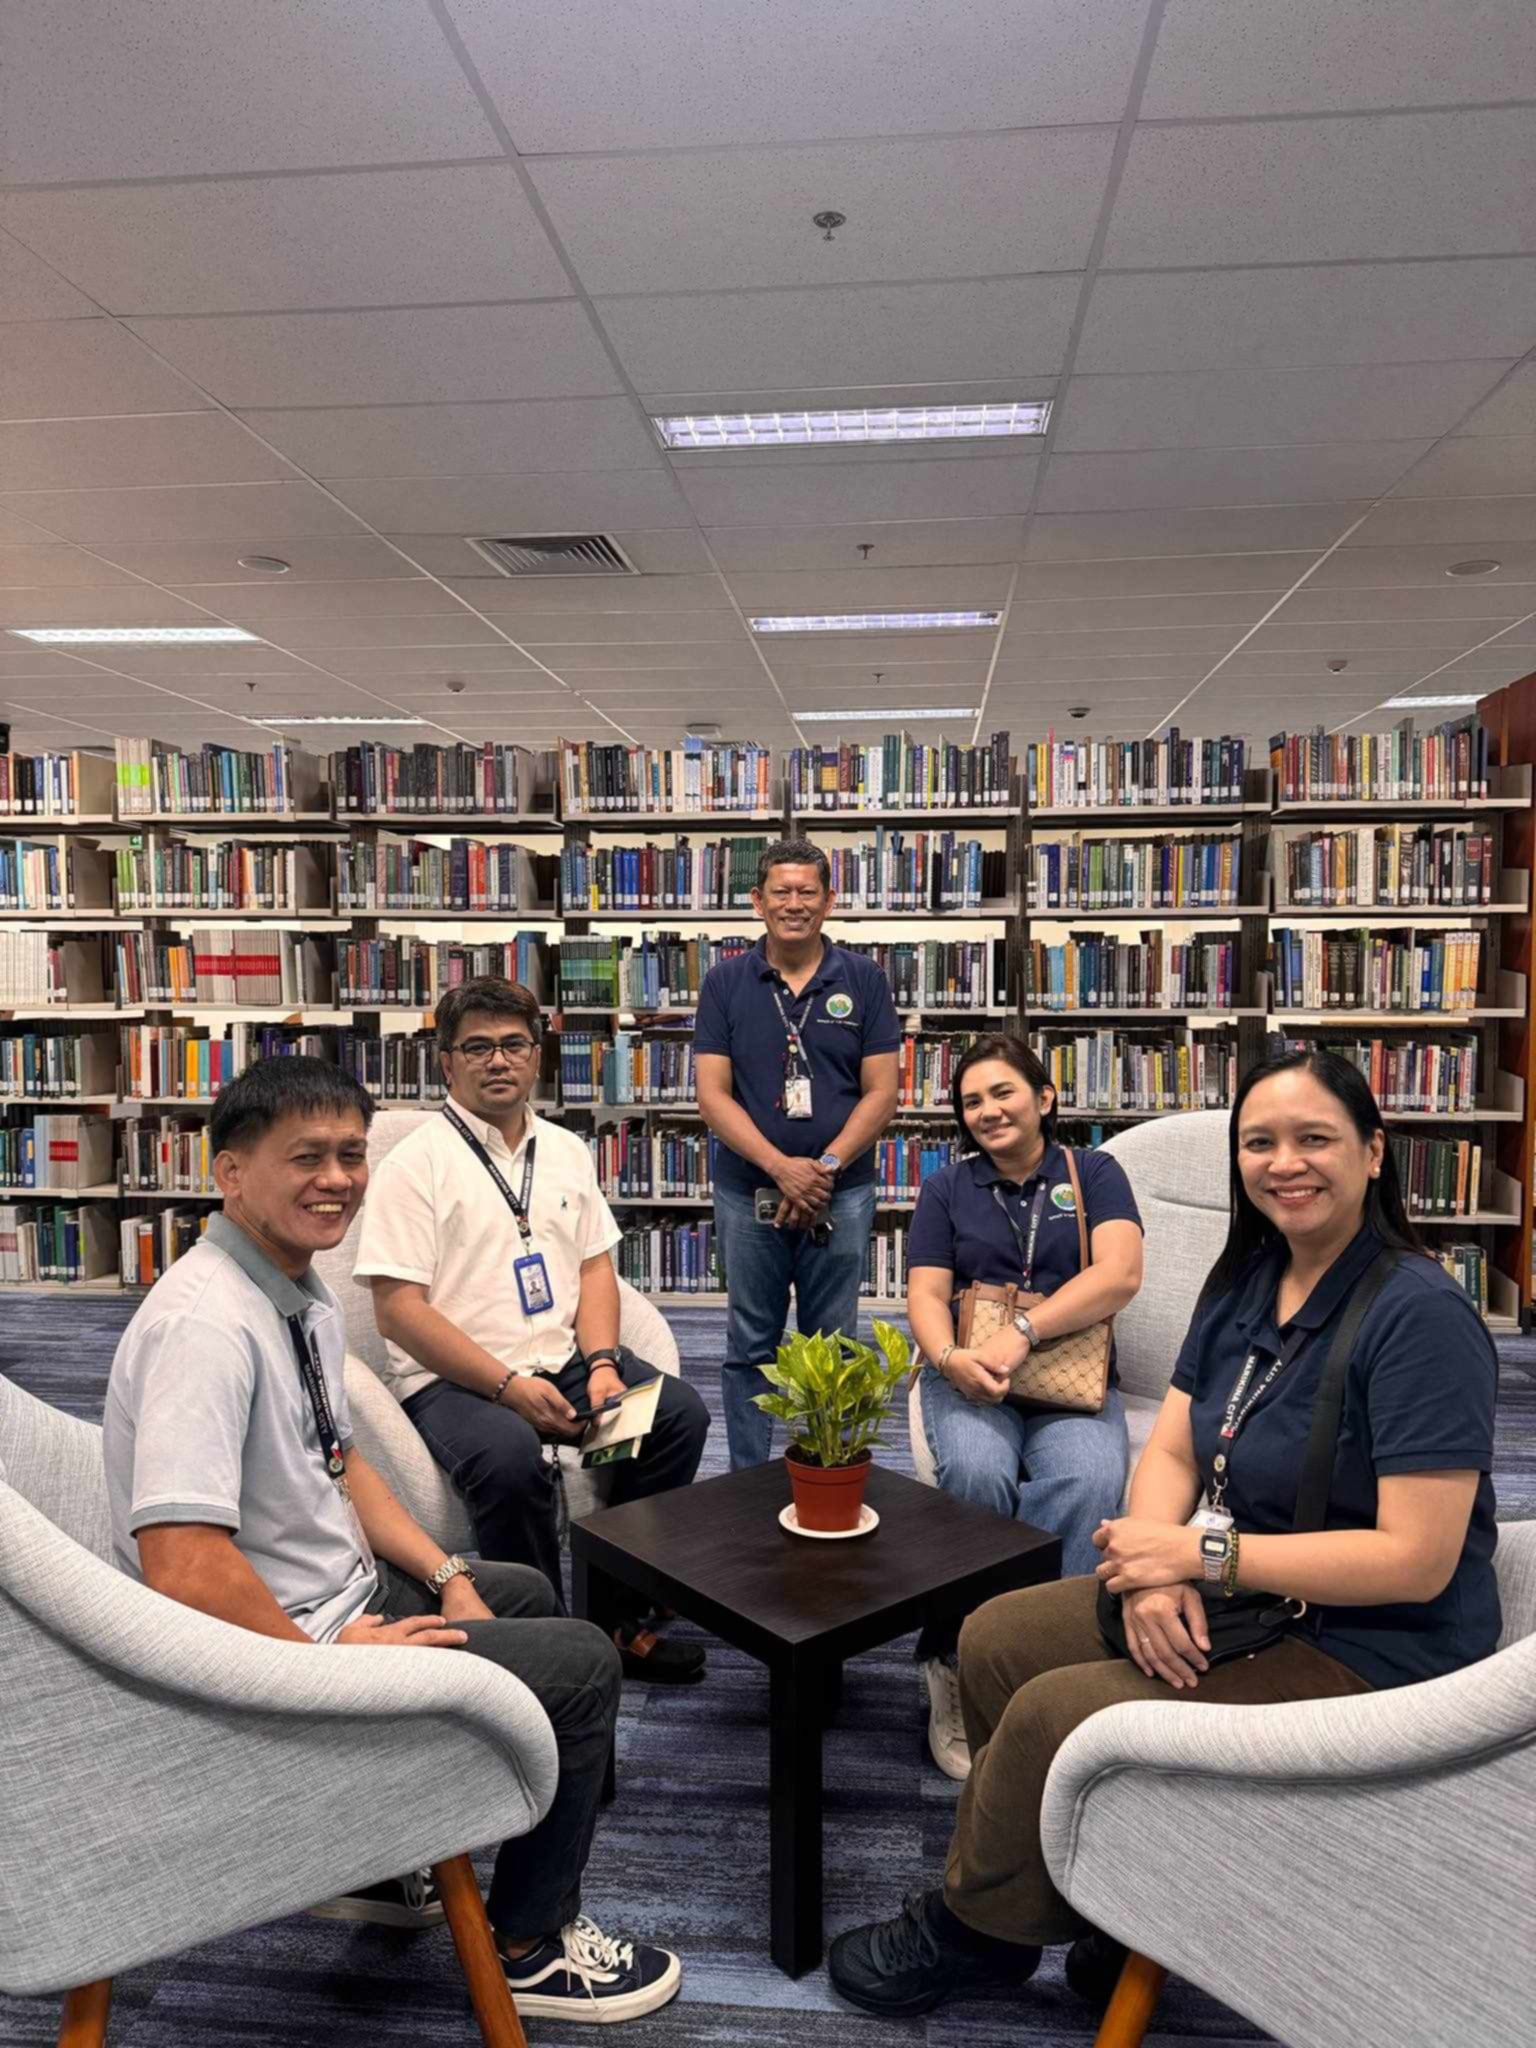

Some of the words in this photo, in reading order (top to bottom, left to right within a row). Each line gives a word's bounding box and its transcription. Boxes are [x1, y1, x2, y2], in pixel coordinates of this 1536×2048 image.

[461, 1126, 473, 1142] CITY
[488, 1163, 509, 1195] MARIKINA
[507, 1194, 519, 1209] CITY
[1031, 1214, 1040, 1229] CITY
[1232, 1355, 1256, 1402] MARIKINA
[1265, 1358, 1283, 1382] CITY
[304, 1363, 322, 1414] MARIKINA
[317, 1411, 329, 1435] CITY
[1225, 1402, 1236, 1429] CITY
